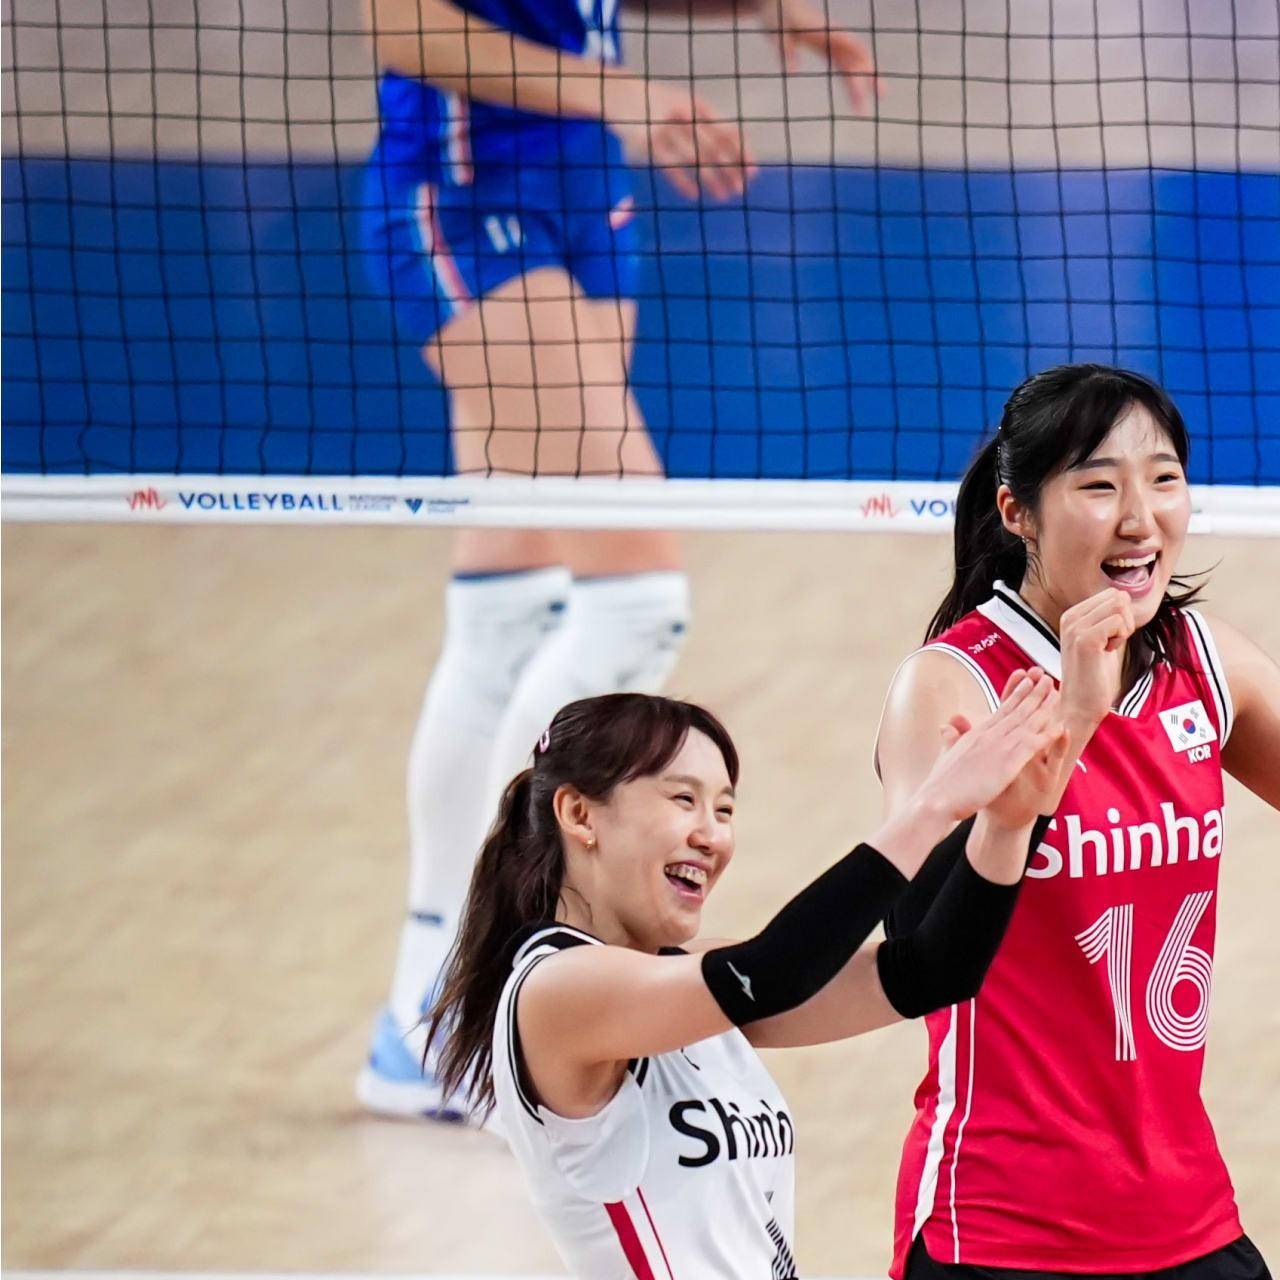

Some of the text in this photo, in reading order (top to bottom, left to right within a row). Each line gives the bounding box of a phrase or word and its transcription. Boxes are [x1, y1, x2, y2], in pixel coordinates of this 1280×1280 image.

[178, 491, 343, 511] VOLLEYBALL
[1186, 744, 1212, 764] KOR
[1025, 801, 1225, 879] Shinha
[1074, 889, 1217, 1062] 16
